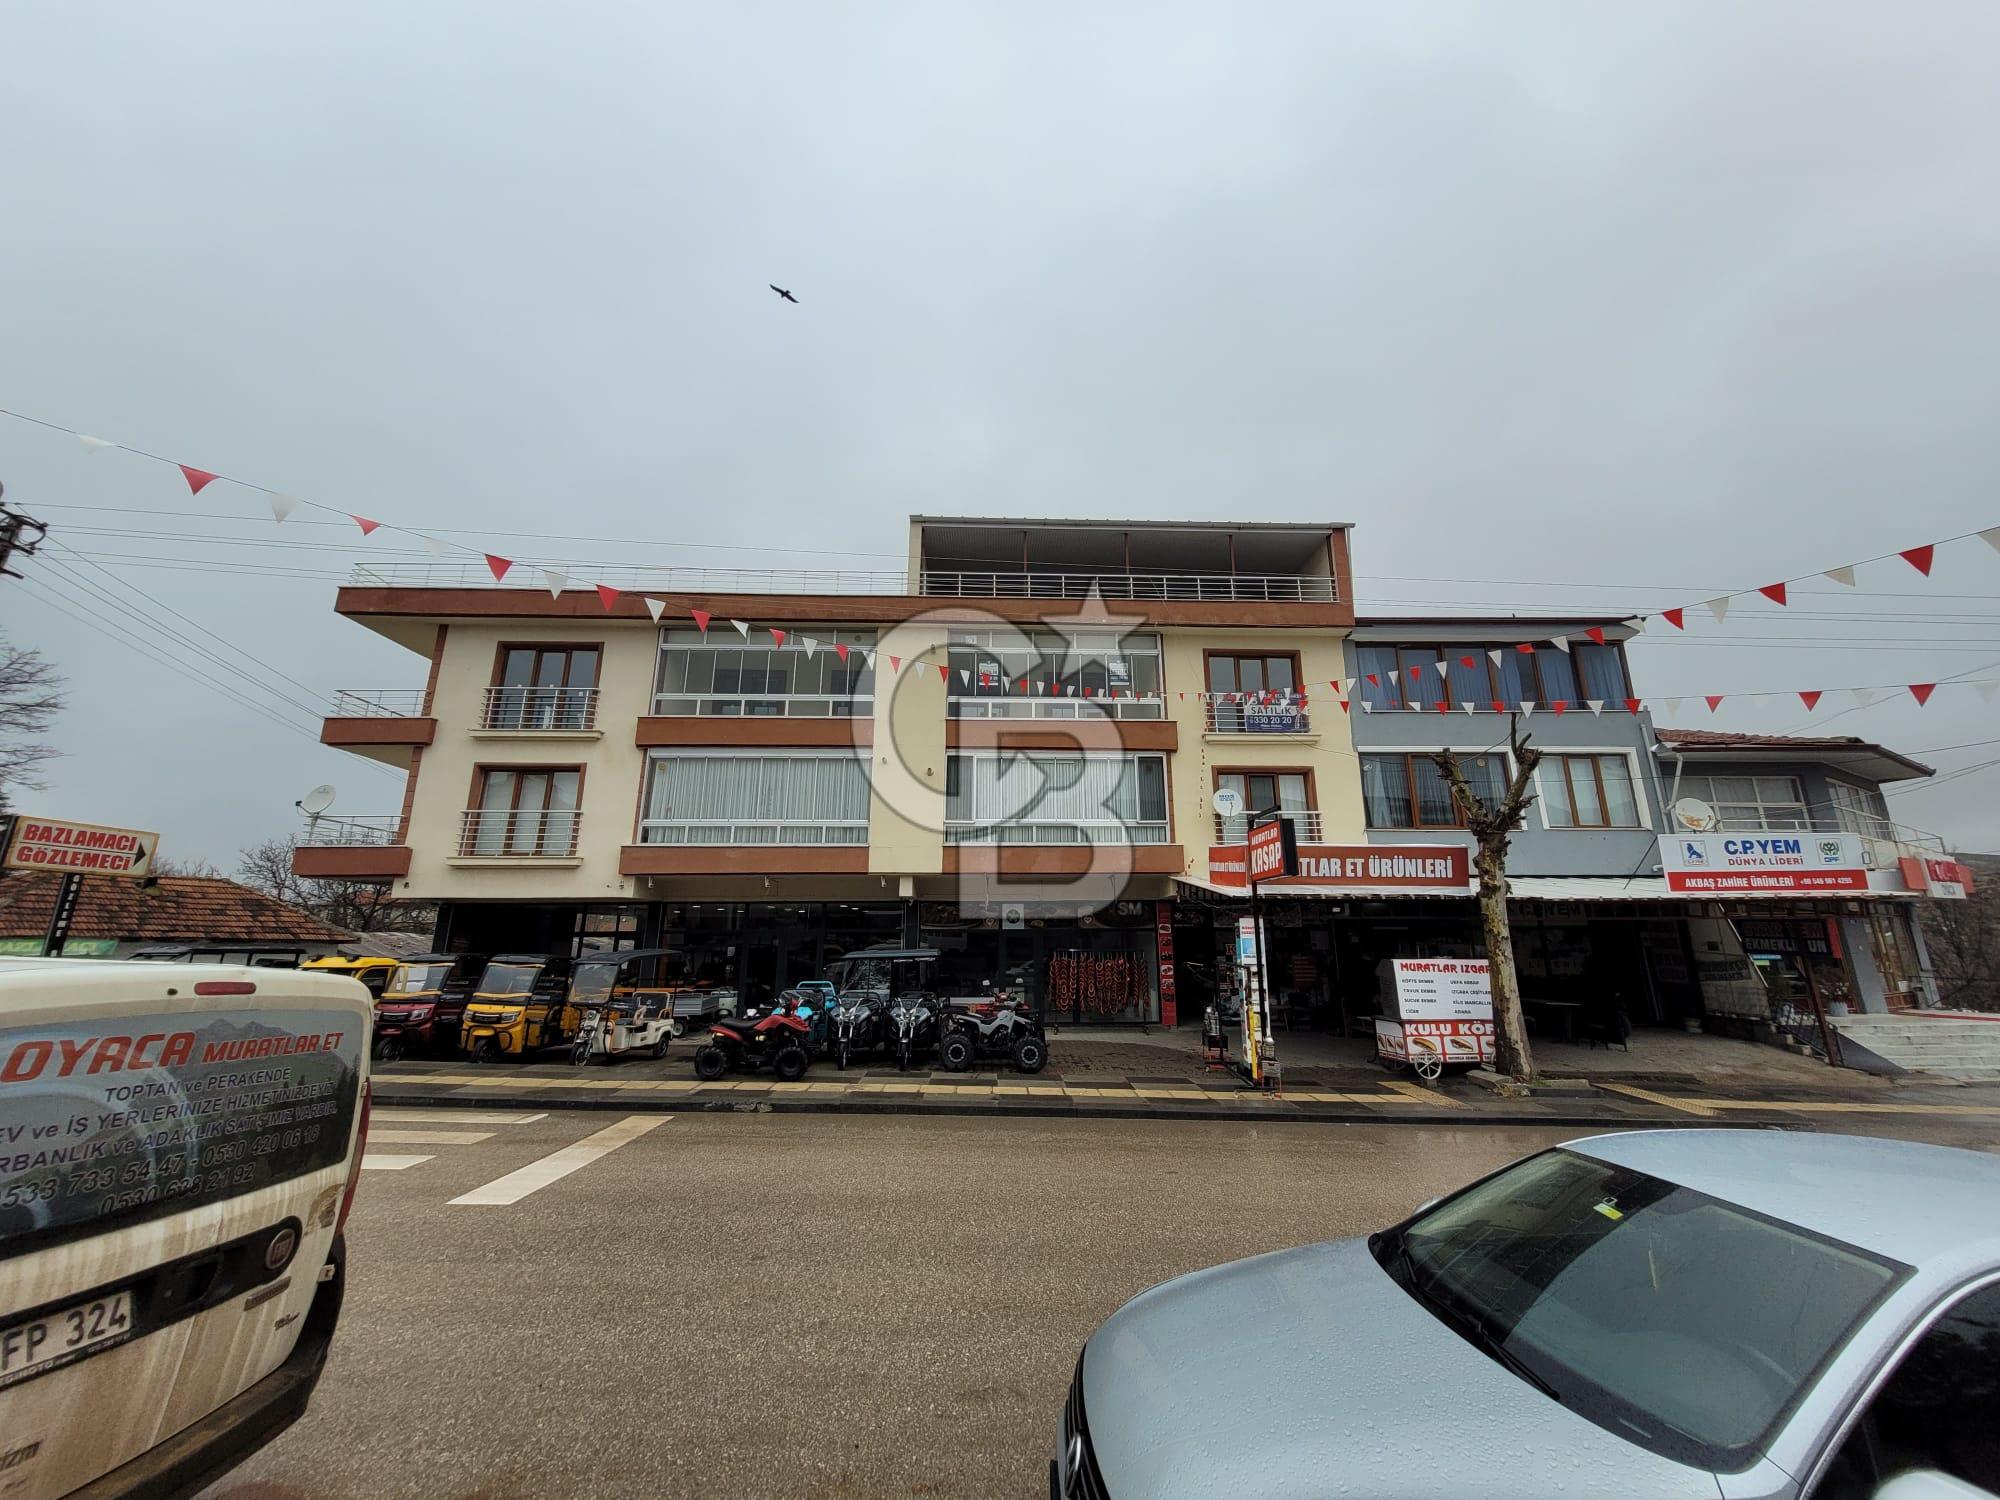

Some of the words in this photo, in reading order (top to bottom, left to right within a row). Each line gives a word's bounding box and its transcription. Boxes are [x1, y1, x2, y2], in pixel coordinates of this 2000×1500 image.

[23, 824, 137, 851] BAZLAMACI
[1251, 828, 1278, 845] MURATLAR
[16, 846, 131, 870] GÖZLEMECİ
[1251, 842, 1282, 874] KASAP
[1346, 858, 1364, 877] ET
[1369, 855, 1453, 878] ÜRÜNLERİ
[1728, 856, 1765, 866] DÜNYA
[1769, 855, 1803, 865] LİDERİ
[1685, 878, 1715, 889] AKBAŞ
[1717, 876, 1748, 888] ZAHİRE
[1751, 875, 1795, 887] ÜRÜNLERİ
[1400, 962, 1458, 974] MURATLAR
[1405, 1024, 1452, 1035] KULU
[1, 1031, 197, 1083] OYACA
[201, 1034, 320, 1064] MURATLAR
[322, 1032, 344, 1052] ET
[105, 1081, 181, 1104] TOPTAN
[184, 1079, 203, 1093] ve
[207, 1067, 291, 1091] PERAKENDE
[32, 1124, 59, 1139] ve
[66, 1114, 89, 1138] İŞ
[113, 1137, 142, 1154] ve
[142, 1123, 222, 1150] ADAKLIK
[0, 1177, 58, 1210] 533
[68, 1166, 116, 1197] 733
[122, 1159, 152, 1185] 54
[157, 1152, 186, 1176] 47
[203, 1139, 246, 1169] 0530
[1, 1323, 47, 1371] FP
[66, 1297, 128, 1347] 324
